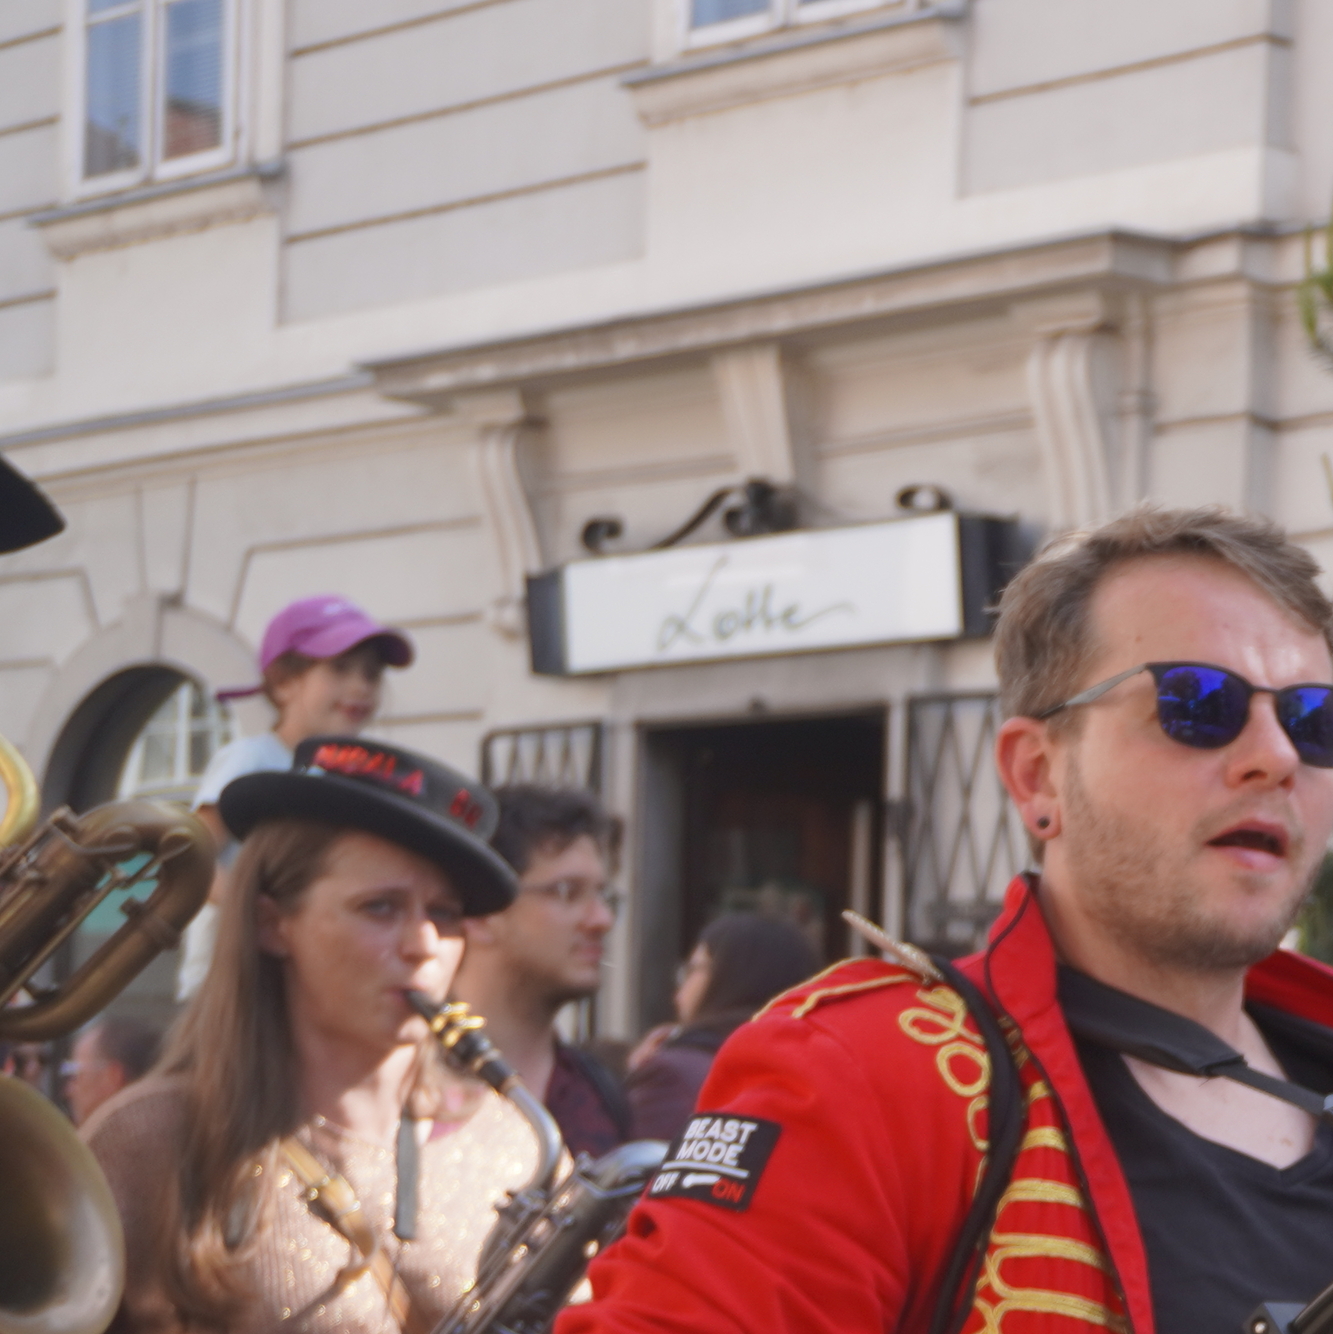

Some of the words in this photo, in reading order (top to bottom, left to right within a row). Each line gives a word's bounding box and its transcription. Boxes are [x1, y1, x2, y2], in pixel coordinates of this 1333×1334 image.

[657, 555, 856, 652] Lotte
[683, 1117, 758, 1144] BEAST
[676, 1140, 745, 1166] MODE
[651, 1171, 681, 1193] OFF
[711, 1178, 745, 1203] ON
